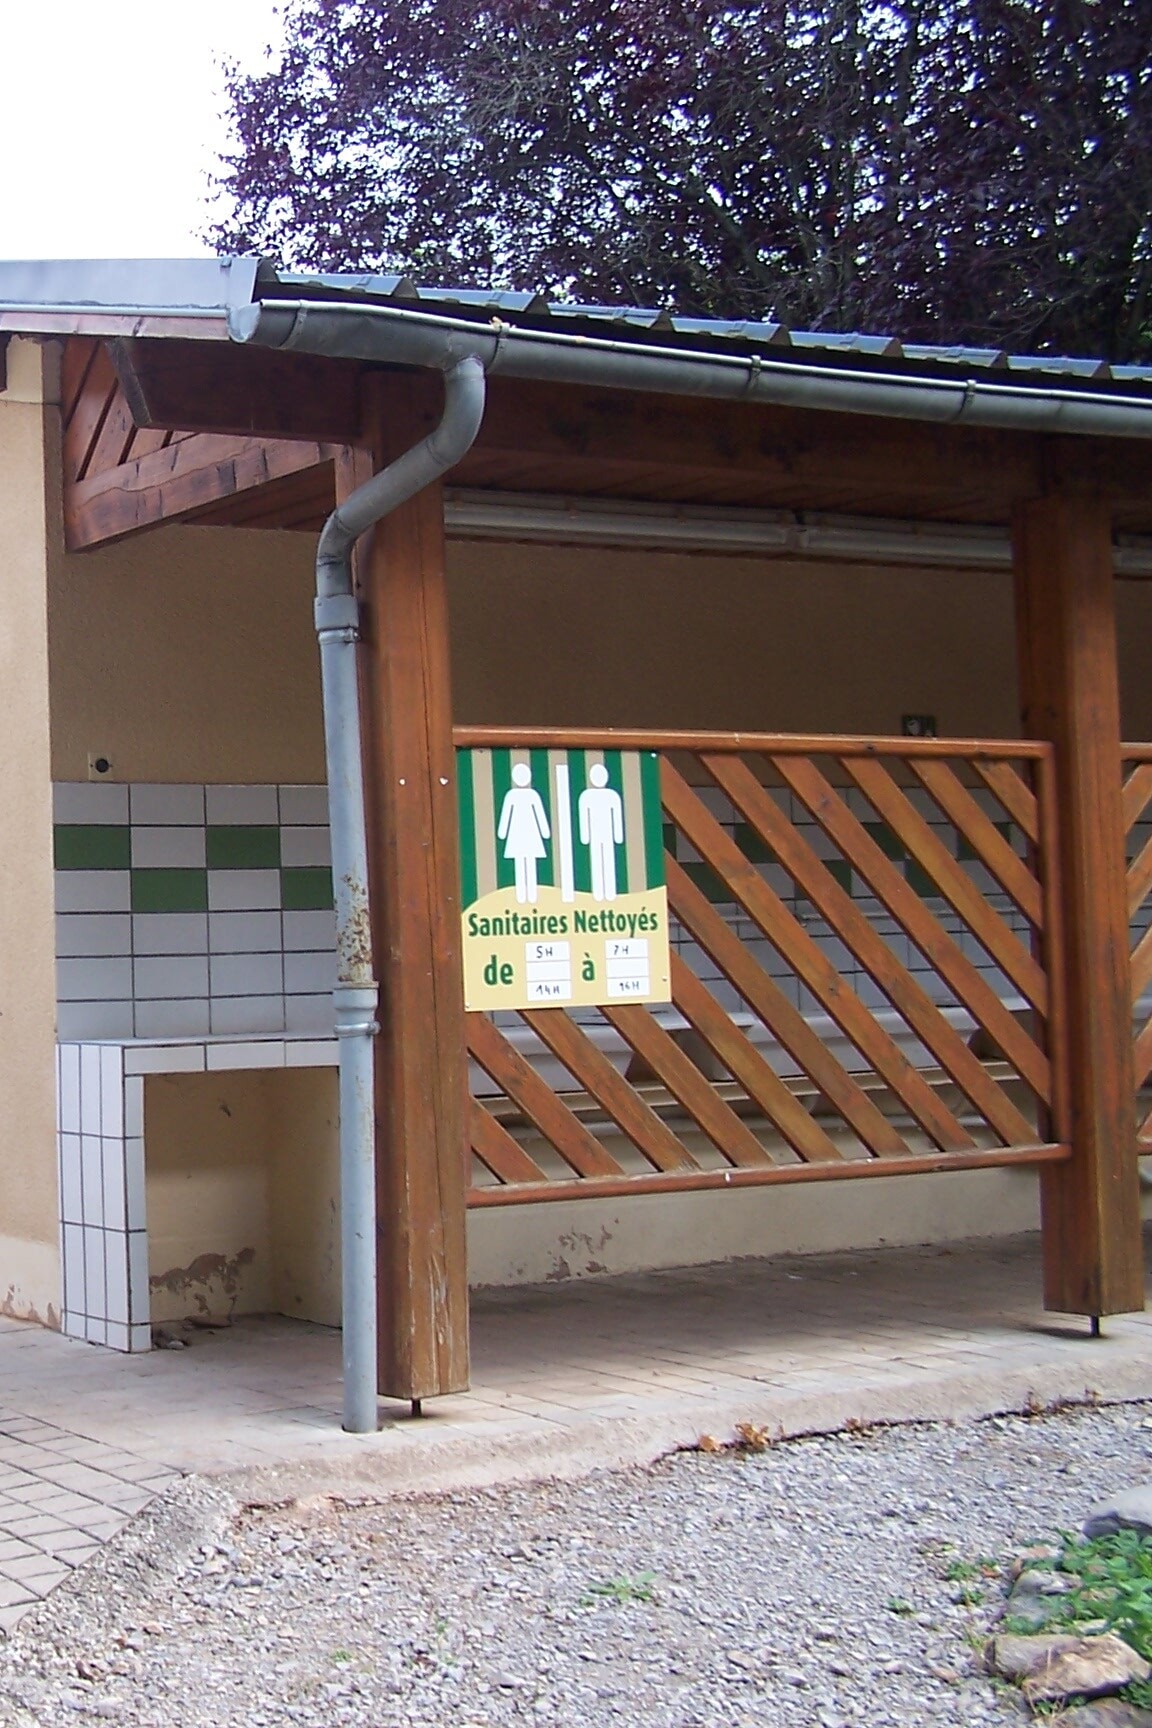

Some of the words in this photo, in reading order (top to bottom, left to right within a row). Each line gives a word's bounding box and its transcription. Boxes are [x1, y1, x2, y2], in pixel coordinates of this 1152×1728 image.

[468, 909, 568, 937] Sanitaires
[574, 907, 658, 938] Nettoyés
[484, 954, 514, 986] de
[582, 952, 596, 982] à
